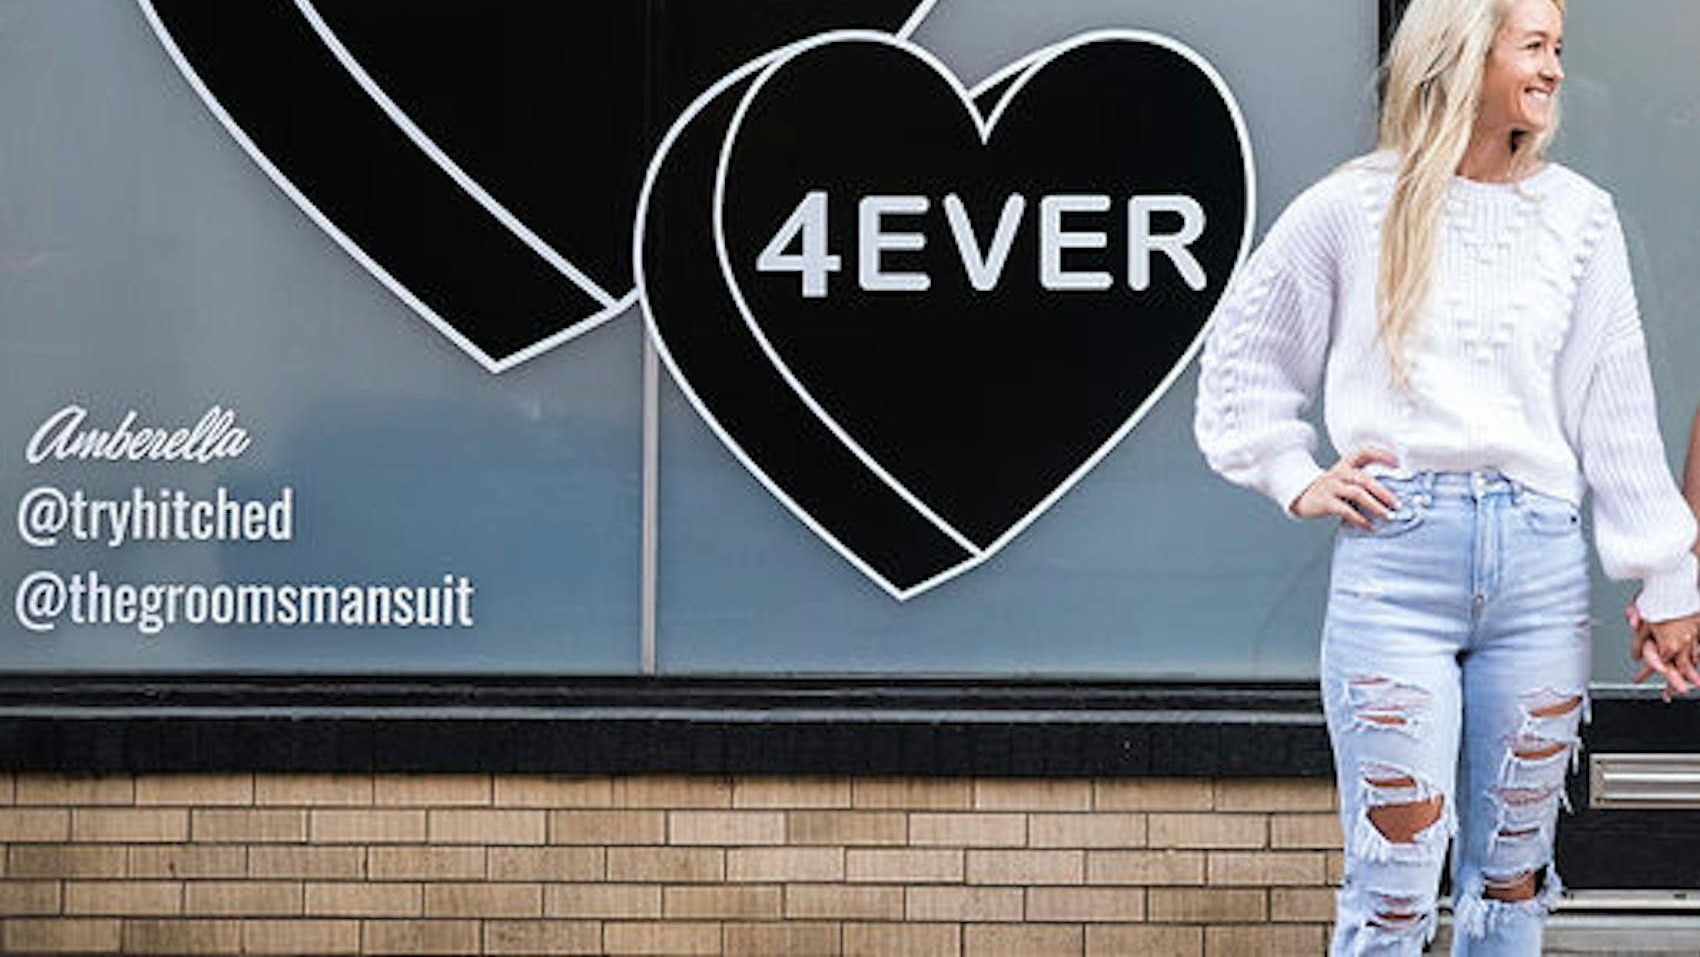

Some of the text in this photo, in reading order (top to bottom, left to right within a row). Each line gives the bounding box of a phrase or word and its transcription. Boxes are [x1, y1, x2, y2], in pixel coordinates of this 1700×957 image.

[756, 192, 1207, 299] 4EVER
[25, 404, 251, 464] Amberella
[18, 486, 293, 547] @tryhitched
[15, 570, 475, 634] @thegroomsmansuit
